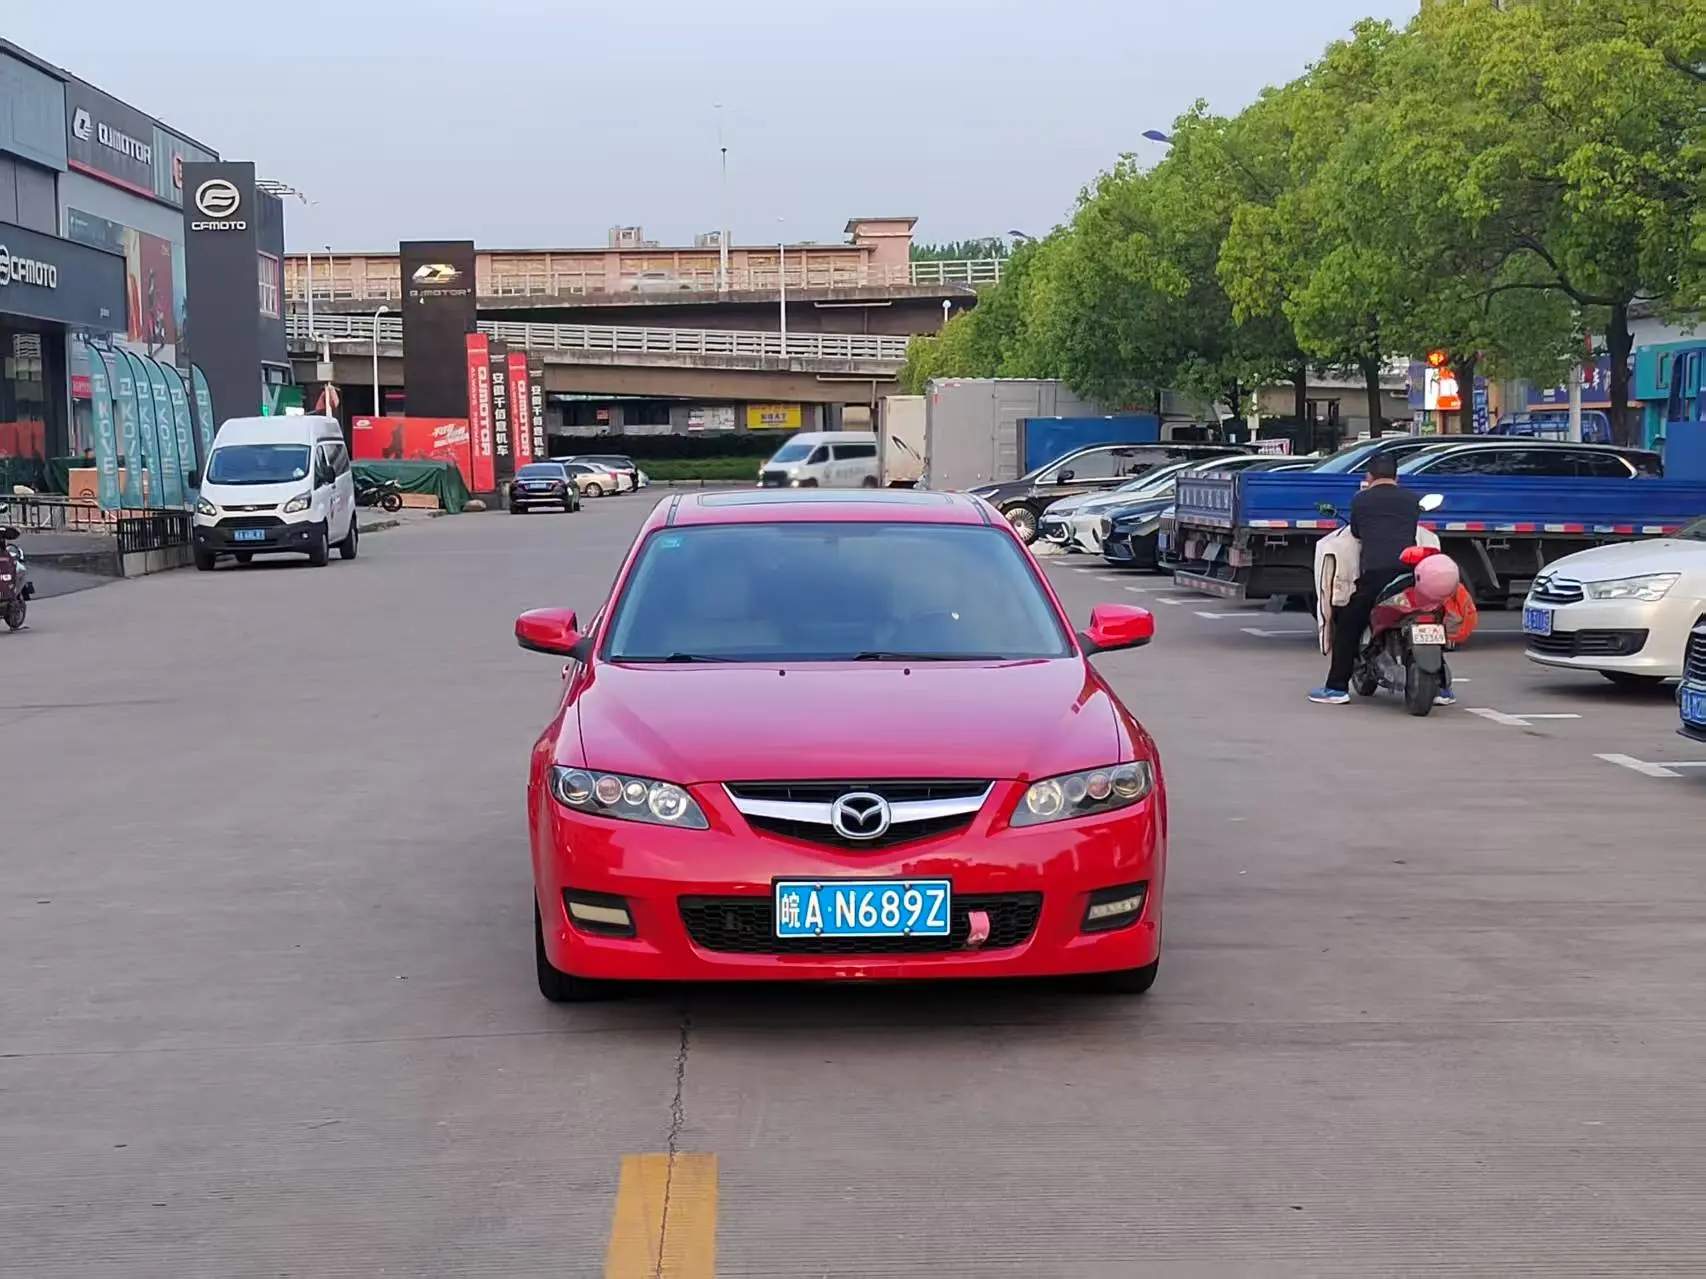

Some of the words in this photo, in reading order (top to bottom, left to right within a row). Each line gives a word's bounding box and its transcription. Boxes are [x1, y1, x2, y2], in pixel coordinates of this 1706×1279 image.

[98, 122, 151, 165] QJMOTOR
[192, 221, 246, 230] CFMOTO
[11, 256, 57, 288] CFMOTO
[478, 366, 491, 456] QJMOTOR
[781, 889, 945, 929] 皖A·N689Z
